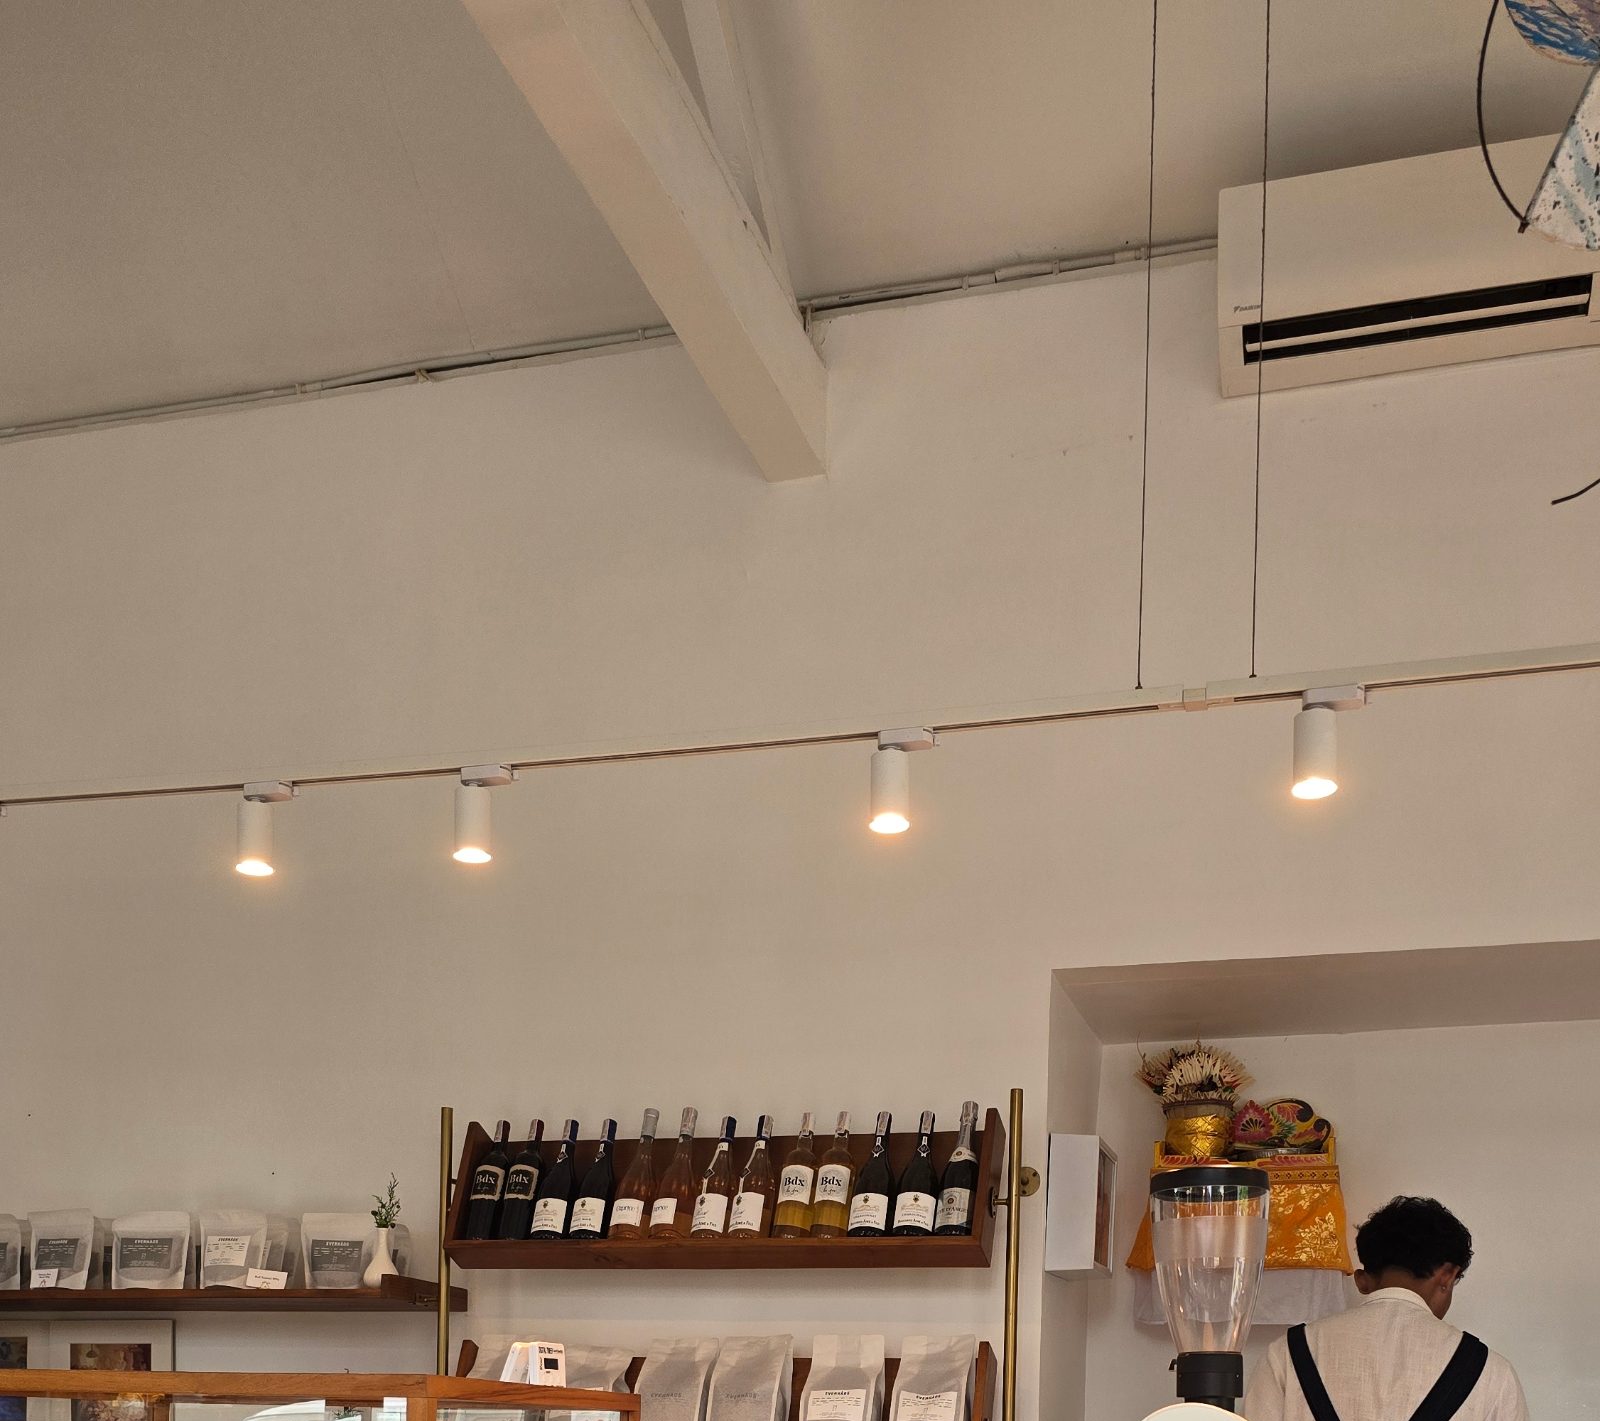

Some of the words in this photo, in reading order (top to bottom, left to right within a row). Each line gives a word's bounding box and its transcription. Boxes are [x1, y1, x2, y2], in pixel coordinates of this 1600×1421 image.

[475, 1174, 496, 1185] Bdx
[509, 1173, 529, 1184] Bdx
[784, 1176, 805, 1187] Bdx
[820, 1176, 842, 1187] Bdx
